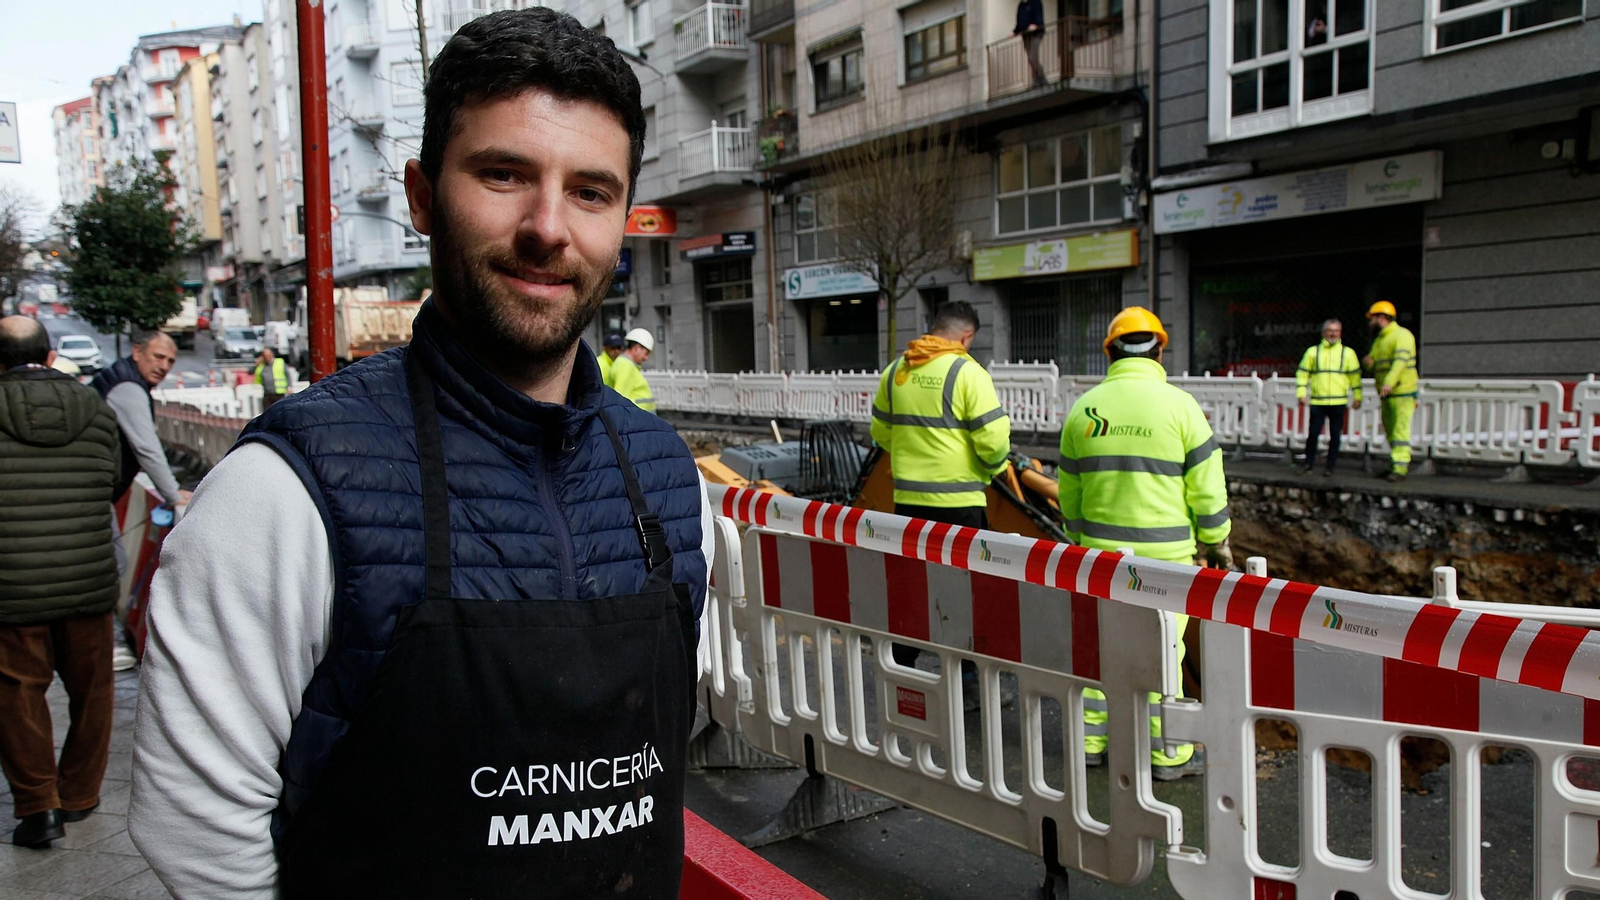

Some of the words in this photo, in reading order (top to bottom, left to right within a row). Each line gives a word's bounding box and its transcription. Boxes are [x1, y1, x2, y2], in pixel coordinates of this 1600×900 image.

[1110, 424, 1153, 438] MISTURAS
[1142, 584, 1168, 597] MISTURAS
[1343, 622, 1379, 637] MISTURAS
[470, 742, 664, 798] CARNICERÍA
[487, 795, 654, 846] MANXAR
